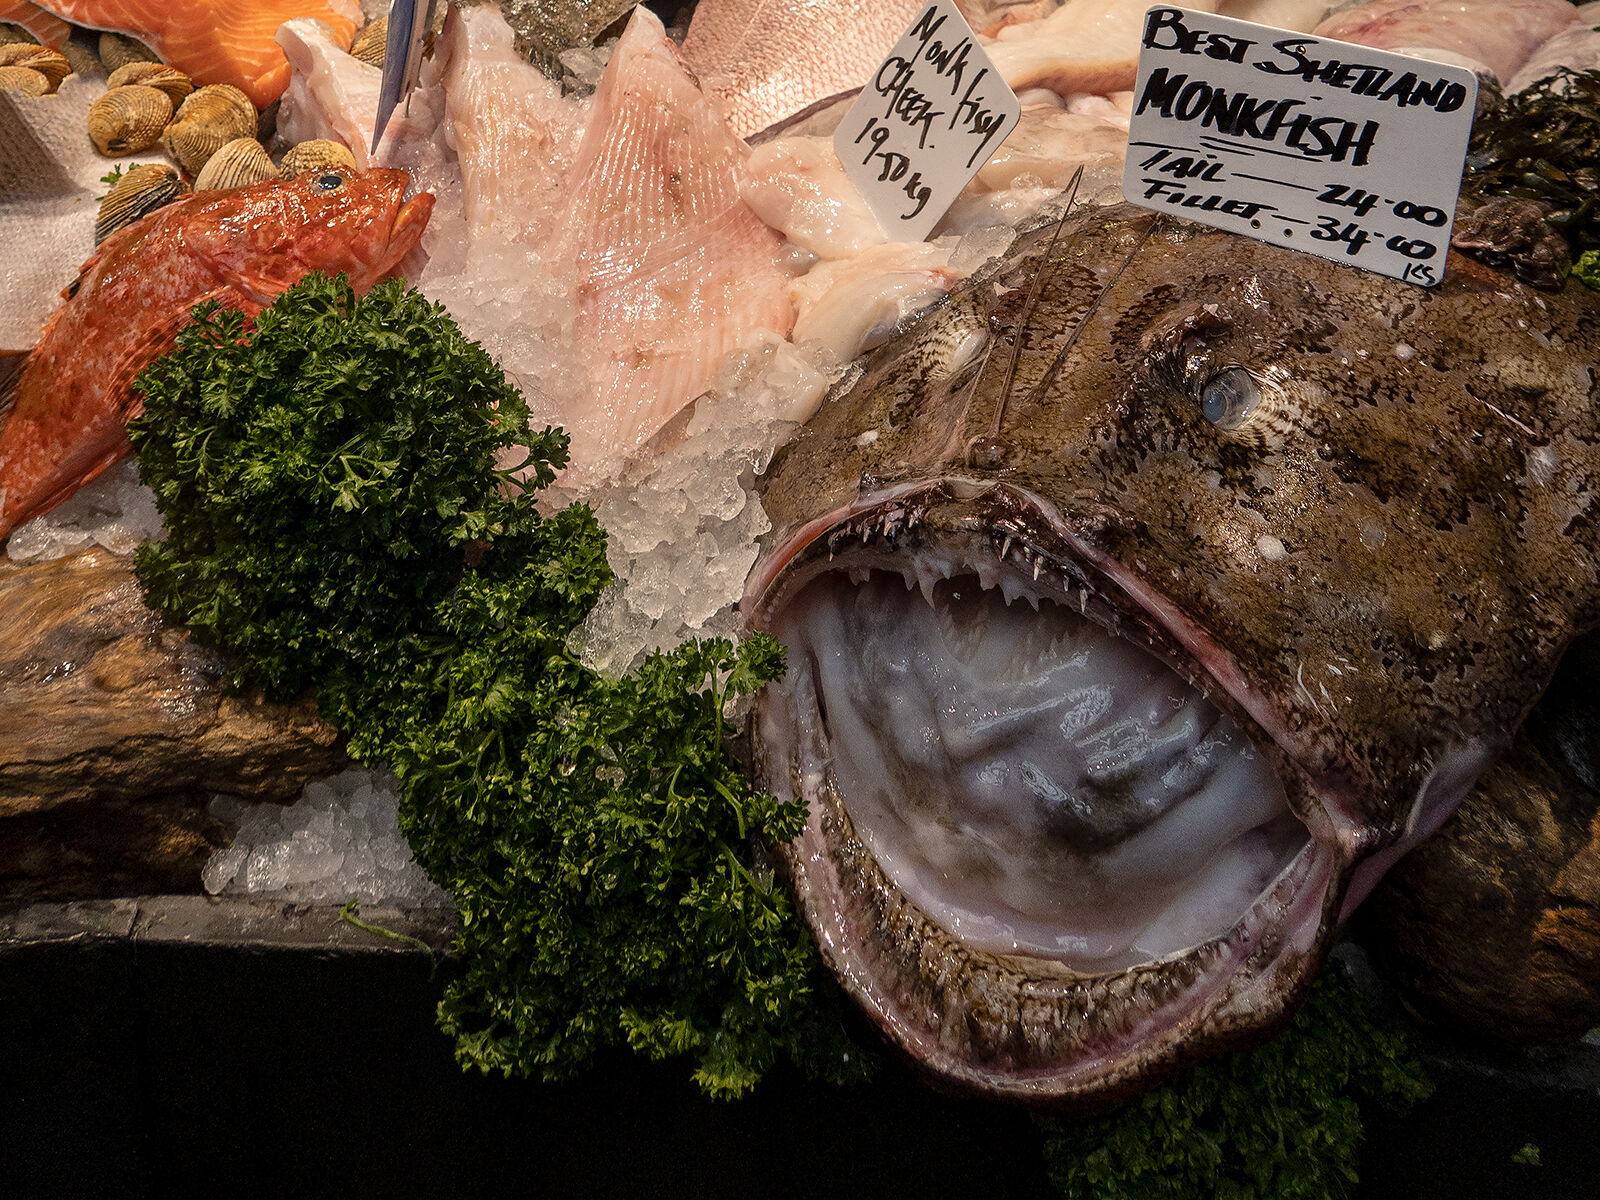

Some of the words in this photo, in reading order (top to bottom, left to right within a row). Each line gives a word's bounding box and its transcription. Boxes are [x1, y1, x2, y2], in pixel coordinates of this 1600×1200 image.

[1141, 8, 1257, 64] BEST
[1252, 39, 1466, 112] SHETLAND
[1135, 68, 1379, 166] MONKFISH
[1128, 141, 1226, 182] TAIL
[1140, 178, 1277, 220] FILLET
